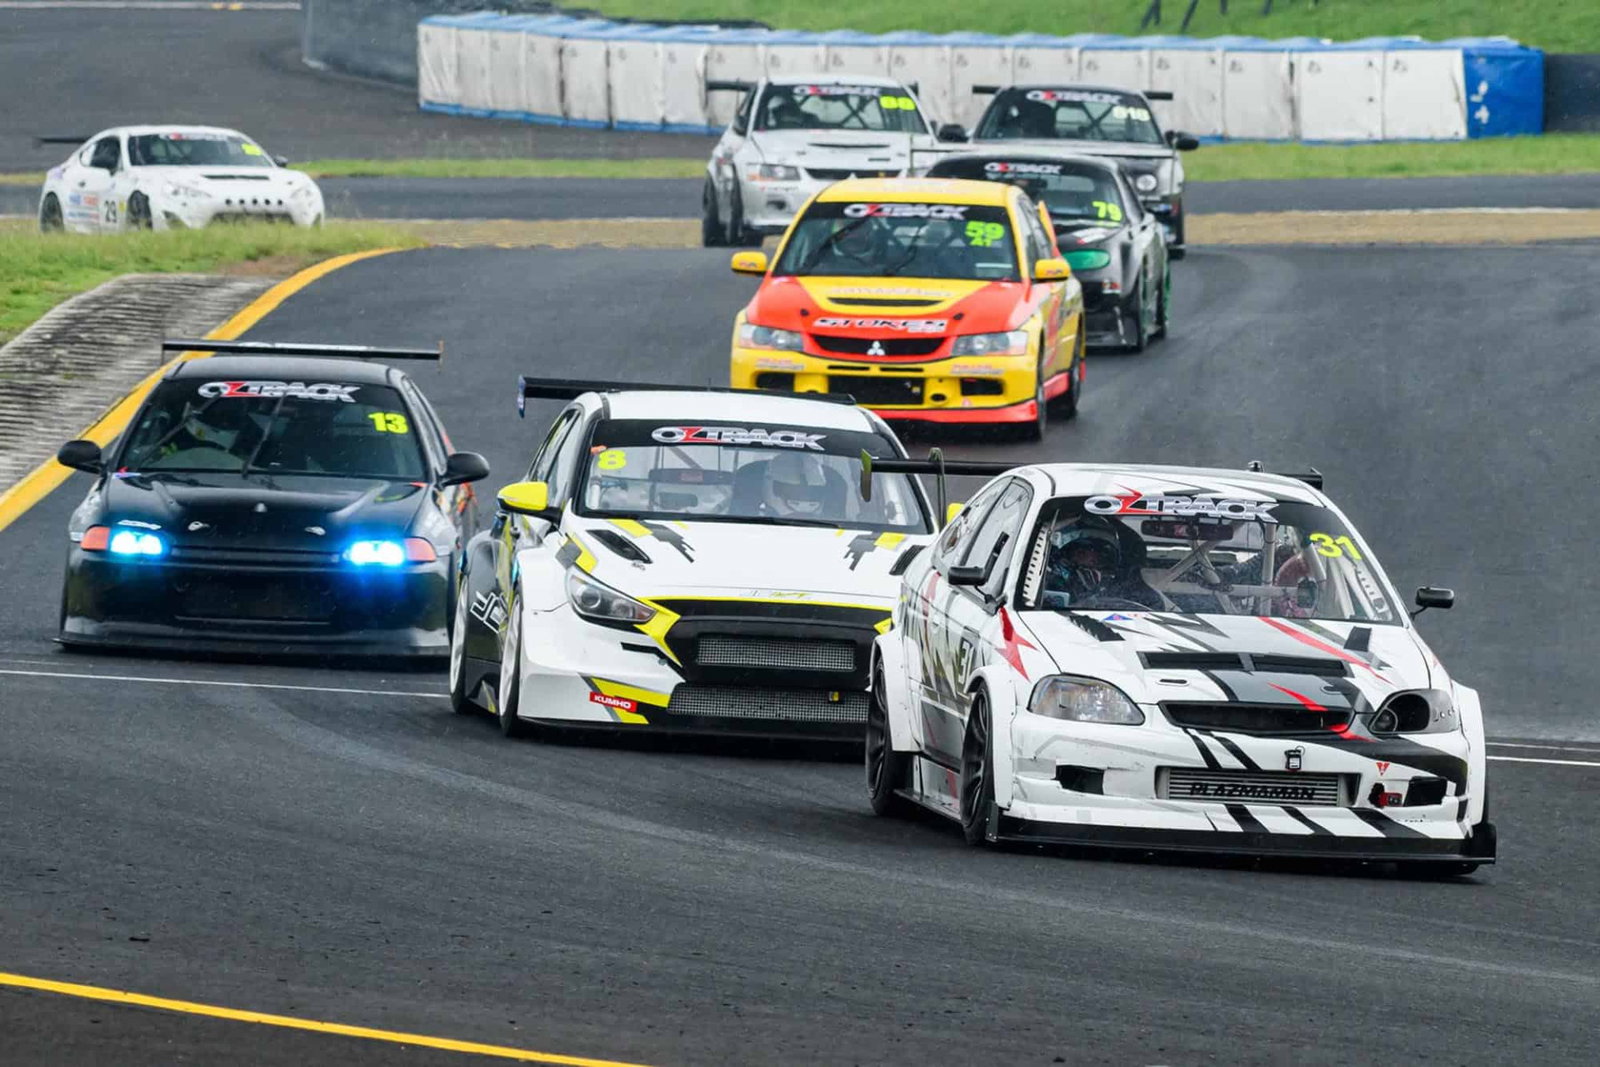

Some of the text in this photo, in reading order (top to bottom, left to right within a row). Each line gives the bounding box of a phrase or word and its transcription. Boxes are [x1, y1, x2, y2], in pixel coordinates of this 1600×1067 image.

[843, 203, 969, 220] OZTRACK
[1092, 201, 1122, 221] 79
[965, 220, 1004, 240] 59
[197, 380, 361, 404] OZTRACK
[368, 411, 409, 435] 13
[650, 426, 826, 452] OZTRACK
[597, 449, 627, 470] 8
[1083, 484, 1279, 524] OZTRACK
[1310, 532, 1363, 561] 31
[593, 694, 633, 710] KUMHO
